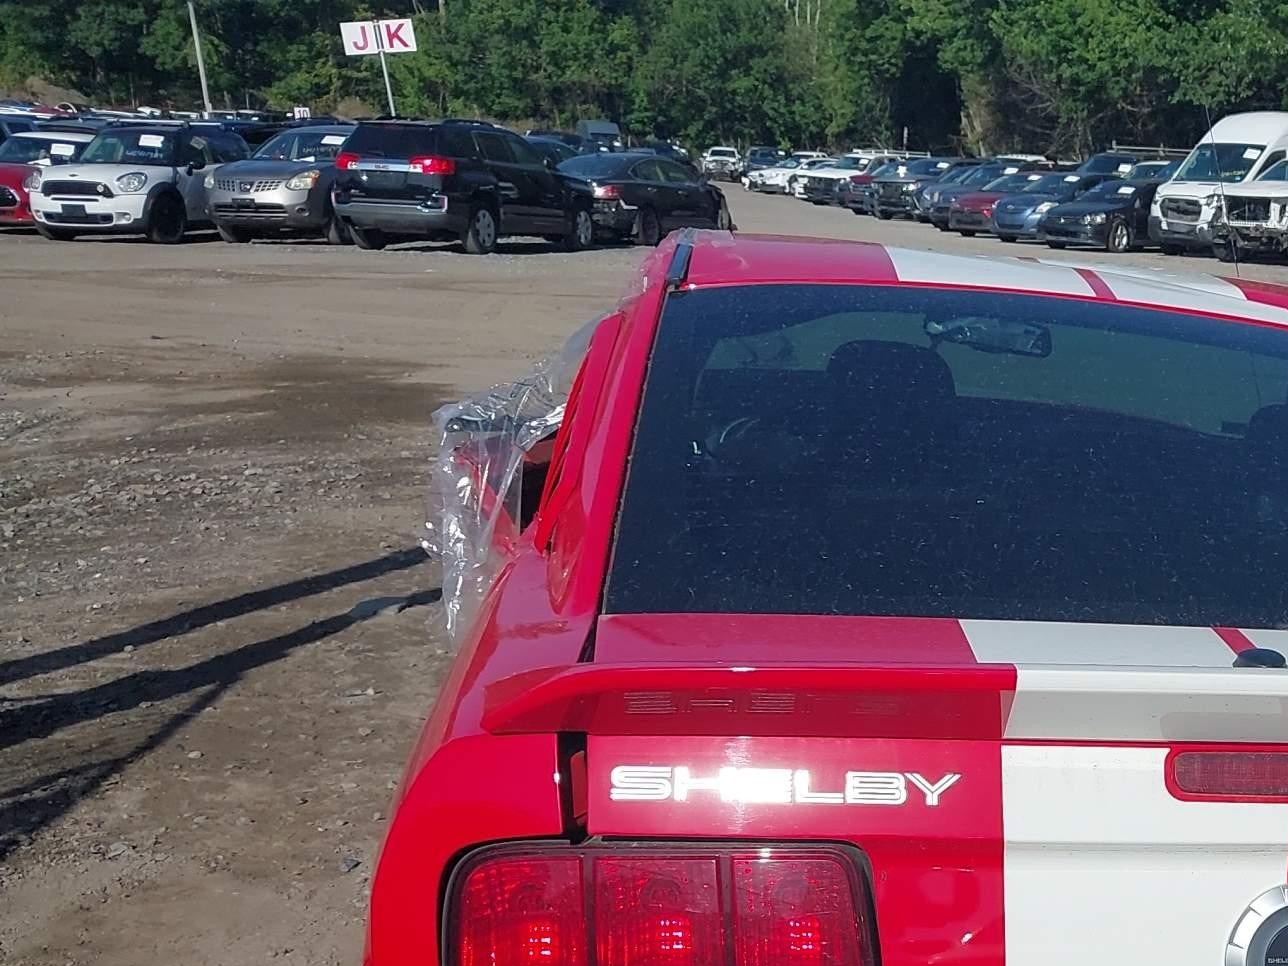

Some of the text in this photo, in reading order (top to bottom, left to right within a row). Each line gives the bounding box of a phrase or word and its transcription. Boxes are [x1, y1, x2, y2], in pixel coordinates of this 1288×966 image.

[352, 23, 411, 51] J K
[610, 765, 961, 806] SHELBY
